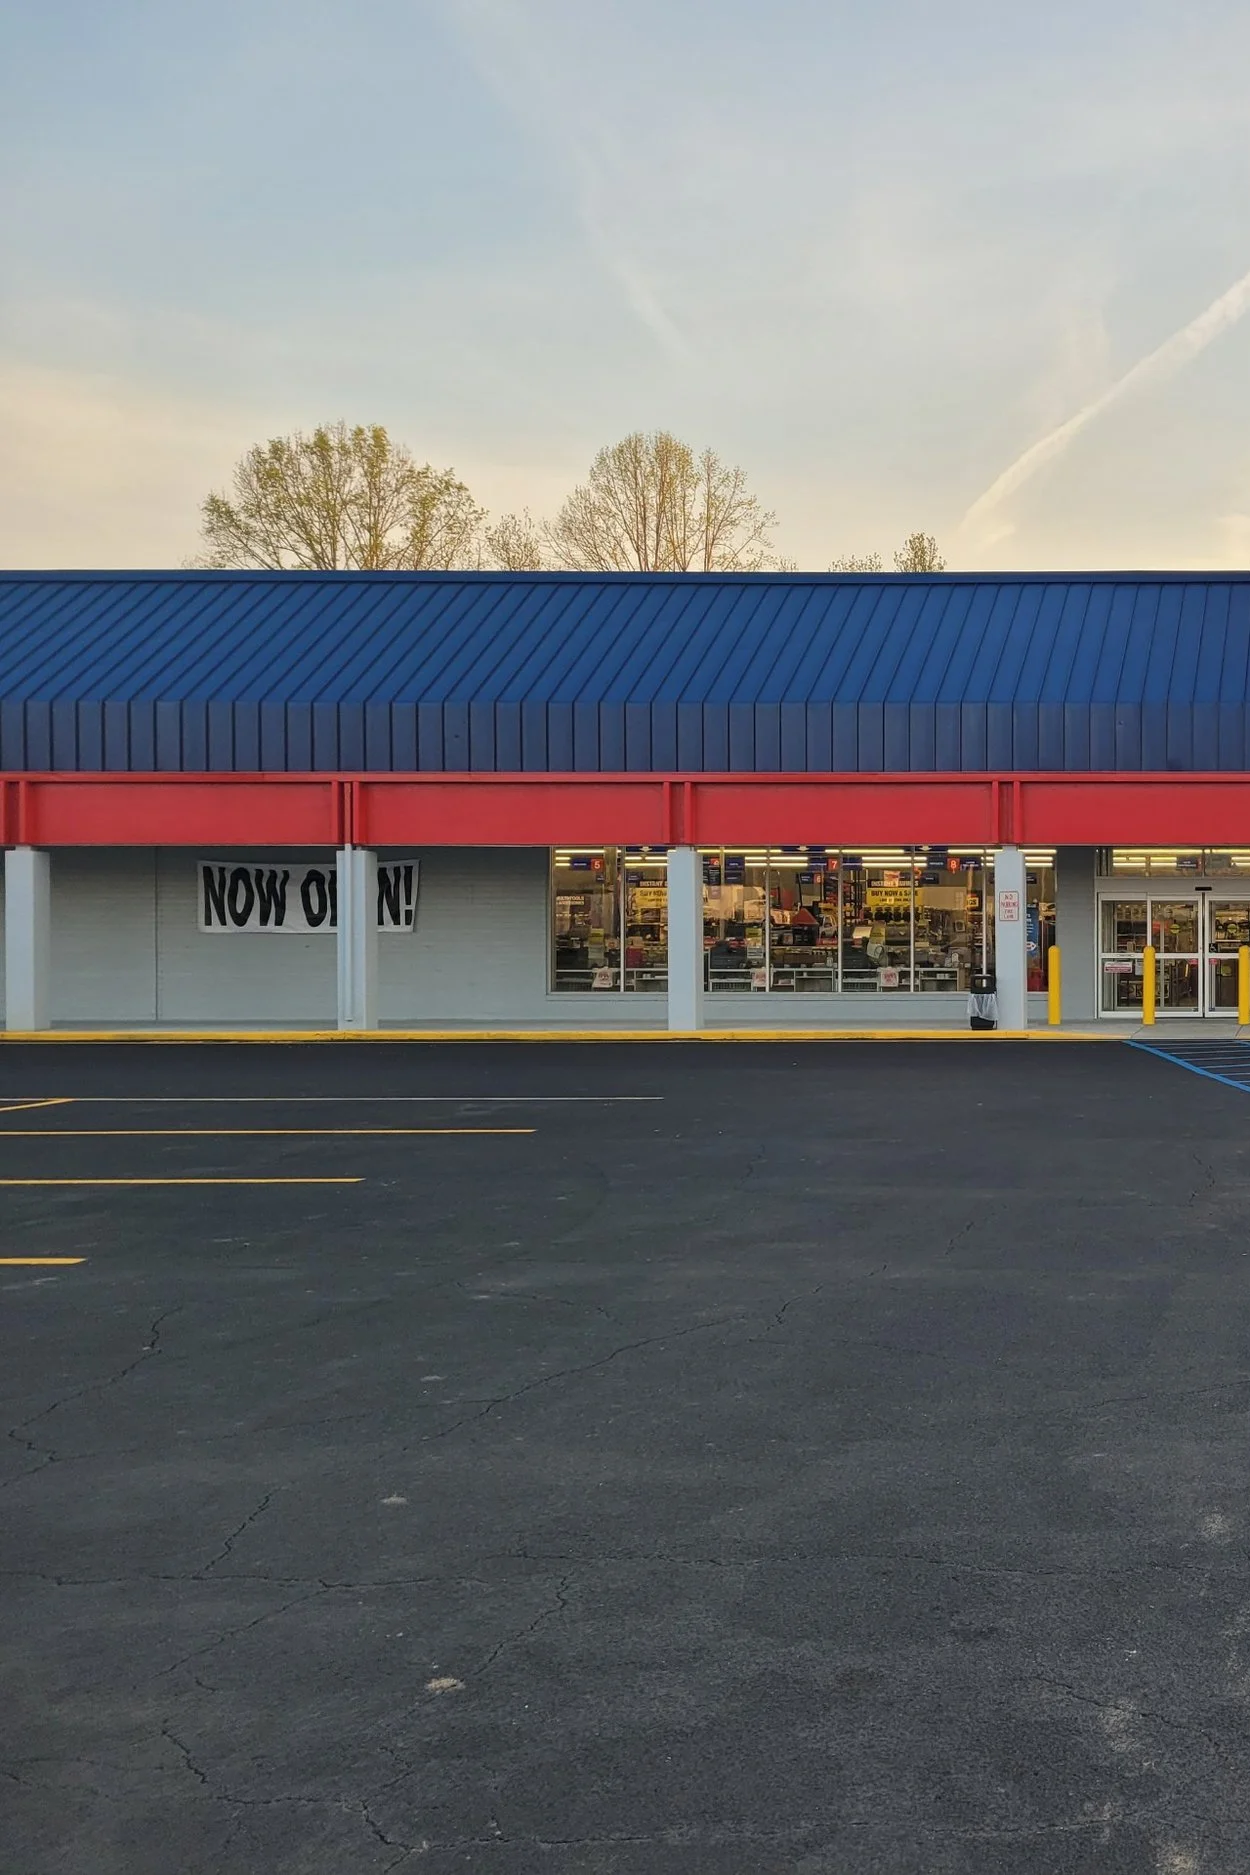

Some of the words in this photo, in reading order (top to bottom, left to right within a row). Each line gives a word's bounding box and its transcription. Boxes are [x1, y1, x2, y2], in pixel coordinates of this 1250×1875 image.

[593, 860, 601, 869] 5
[831, 860, 838, 869] 7
[202, 866, 290, 927] NOW
[301, 866, 414, 927] ON!
